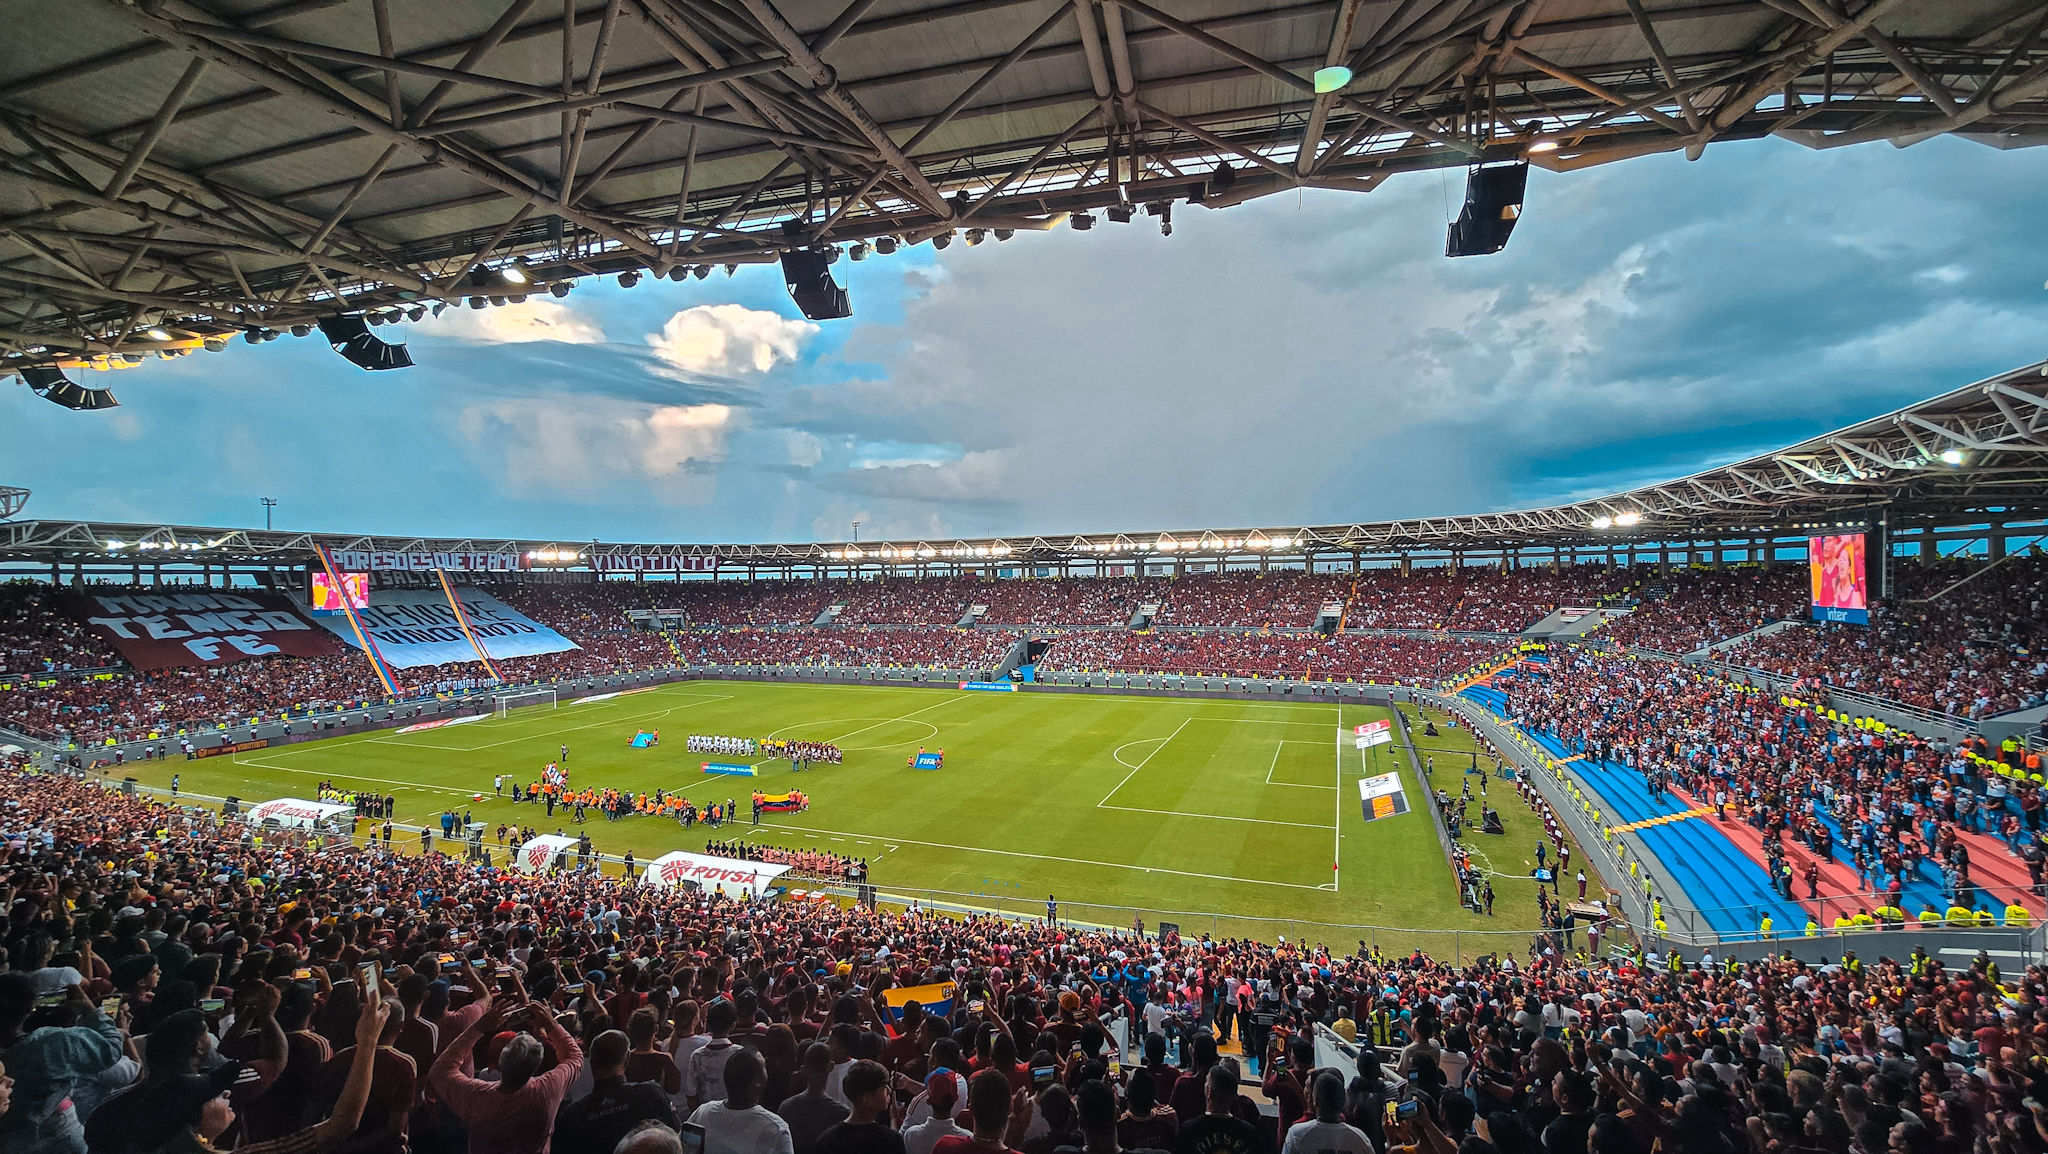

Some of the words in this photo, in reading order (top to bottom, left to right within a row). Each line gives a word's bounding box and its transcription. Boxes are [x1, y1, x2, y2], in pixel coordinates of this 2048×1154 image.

[591, 556, 717, 570] VINOTINTO
[93, 594, 264, 614] MANO
[1827, 607, 1848, 621] inter
[87, 610, 312, 640] TENGO
[183, 634, 281, 661] FE
[919, 757, 935, 765] FIFA
[691, 865, 757, 884] PDVSA
